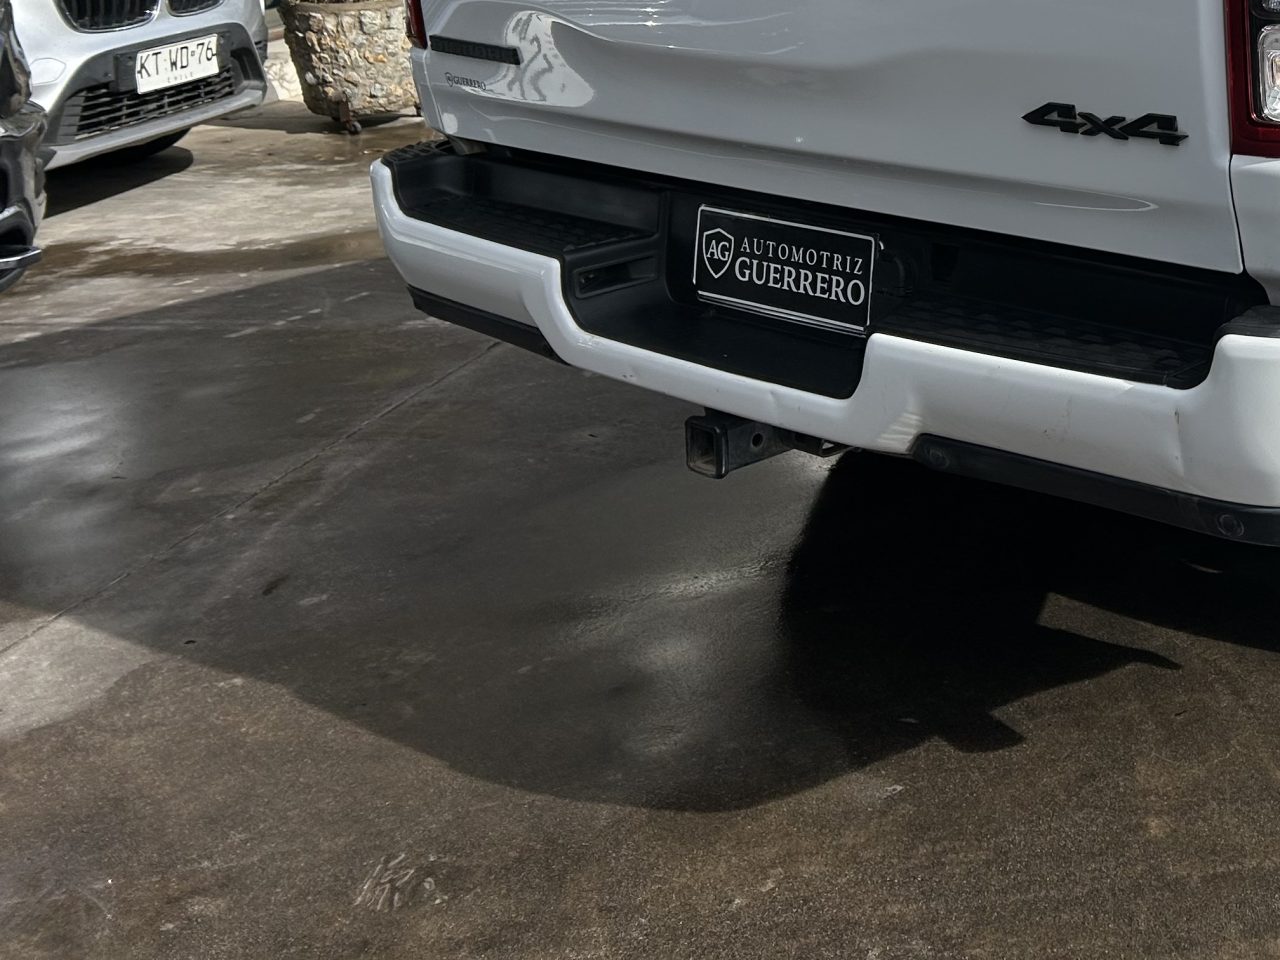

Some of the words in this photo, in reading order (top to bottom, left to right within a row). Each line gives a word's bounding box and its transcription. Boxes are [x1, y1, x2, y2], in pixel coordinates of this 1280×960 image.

[453, 77, 487, 91] GUERRERO
[1021, 102, 1189, 146] 4x4
[706, 239, 730, 261] AG
[740, 237, 863, 275] AUTOMOTRIZ
[734, 256, 865, 305] GUERRERO
